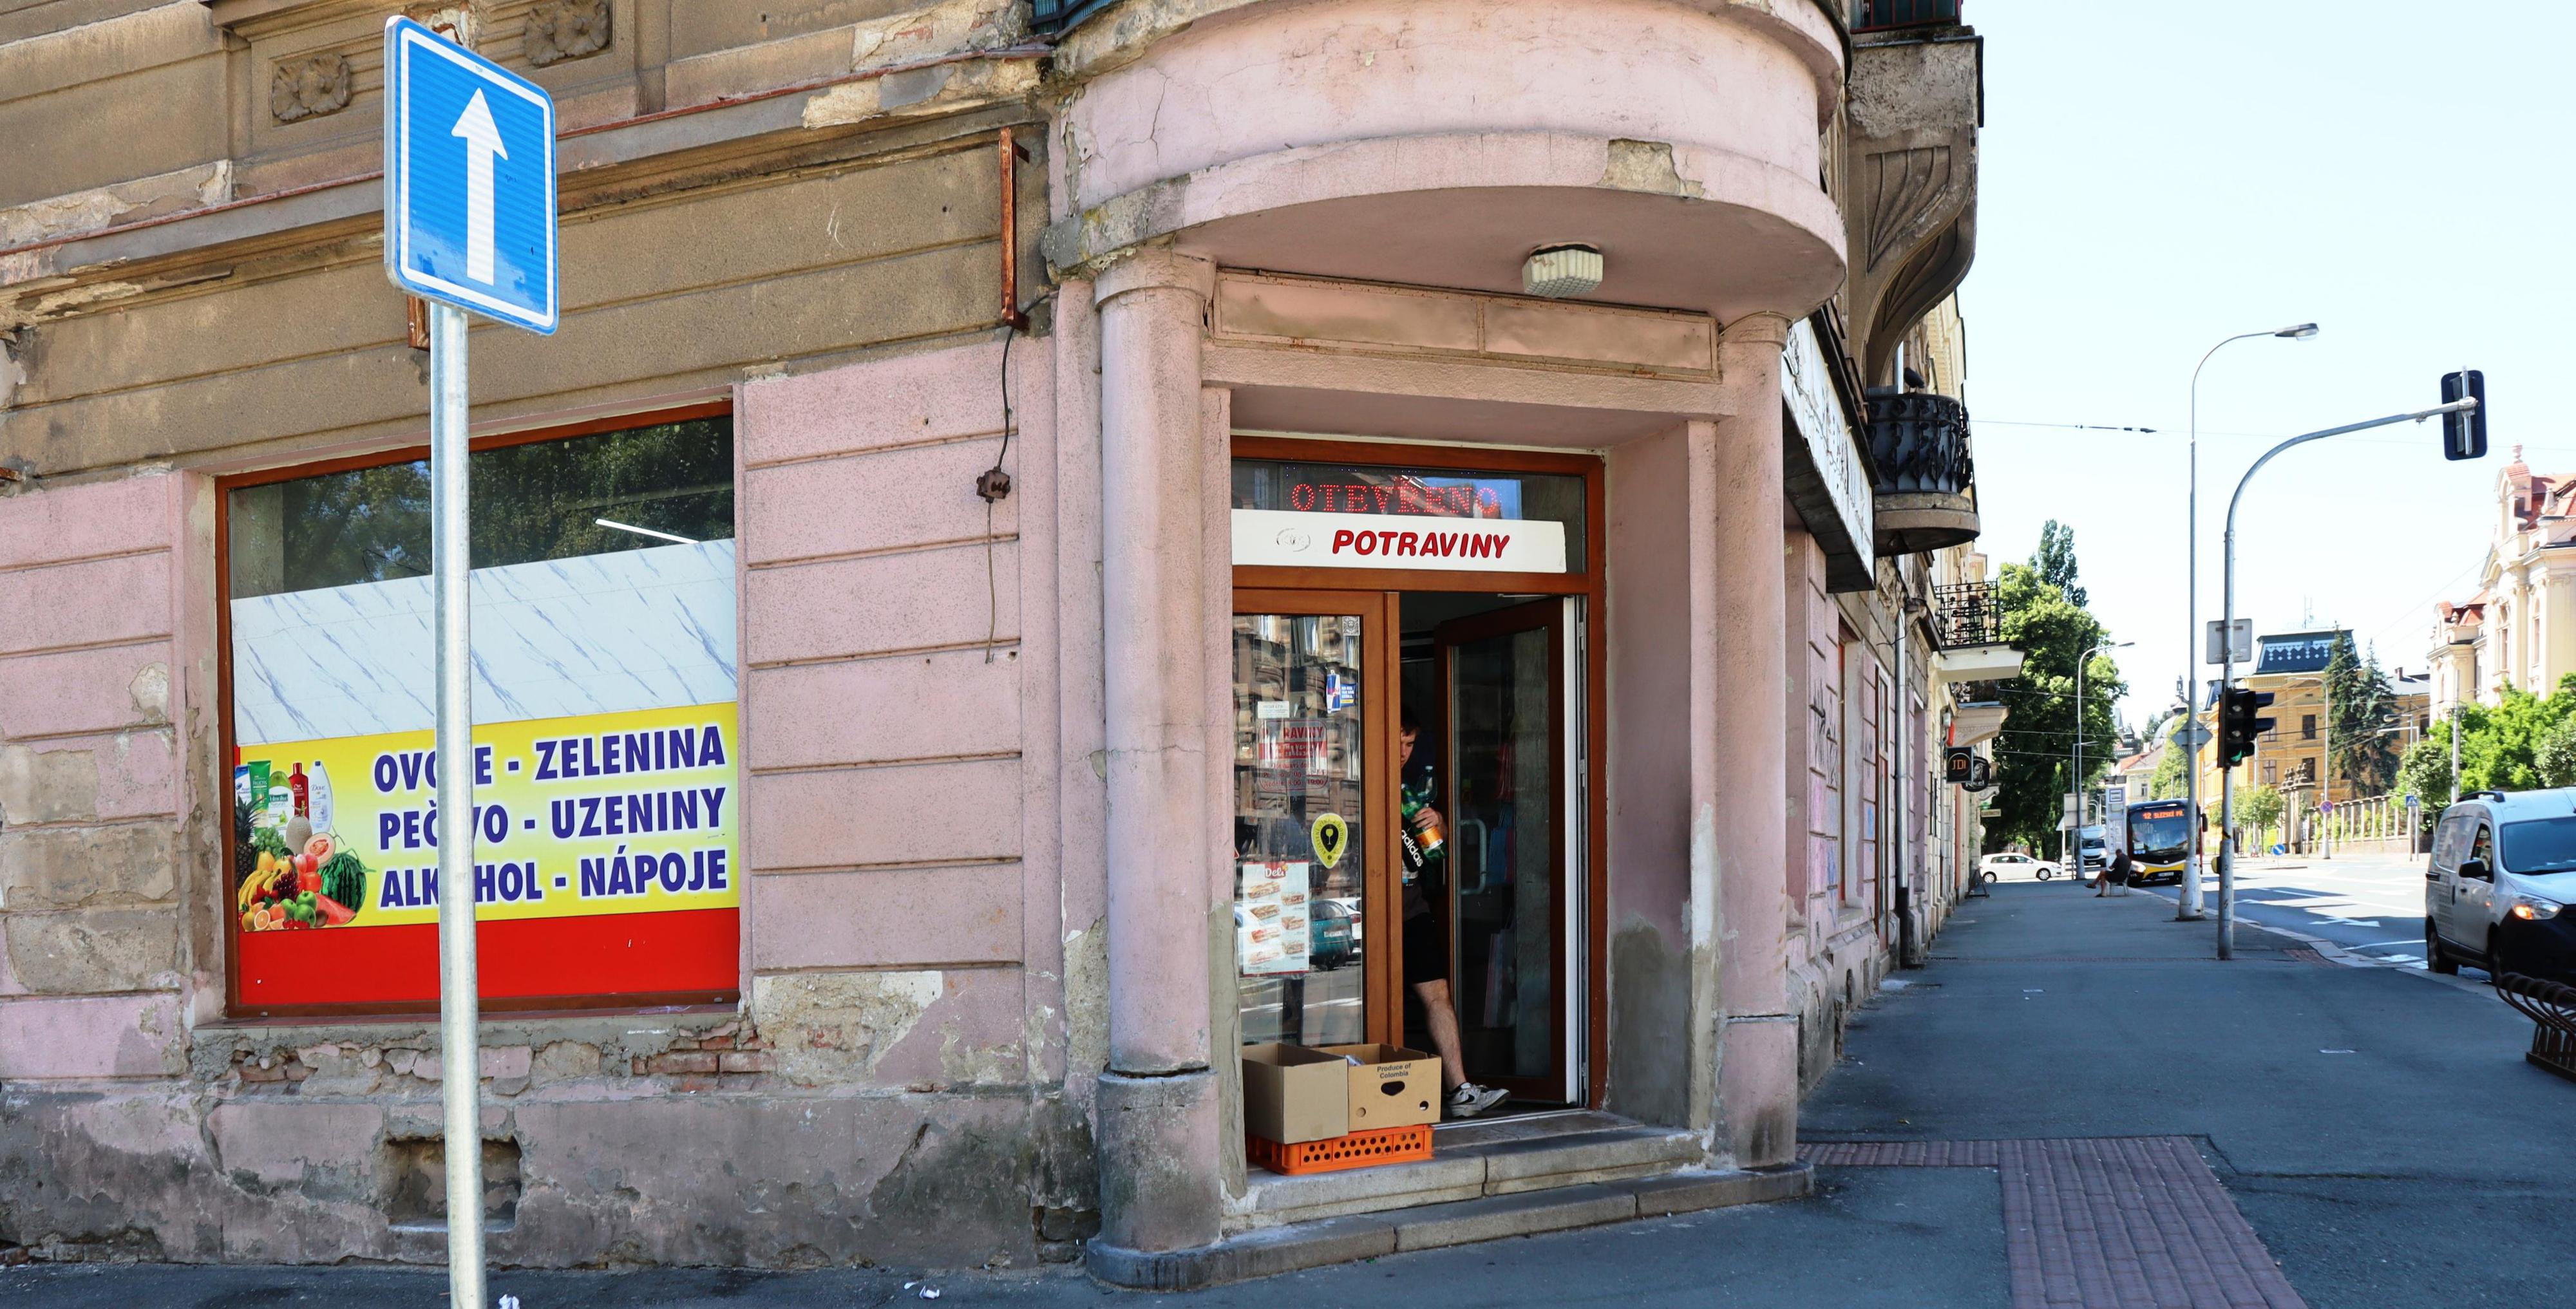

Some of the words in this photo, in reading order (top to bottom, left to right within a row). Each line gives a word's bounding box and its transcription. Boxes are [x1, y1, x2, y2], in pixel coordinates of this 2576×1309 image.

[1291, 475, 1497, 513] OTEVŘENO
[1332, 529, 1510, 559] POTRAVINY
[374, 747, 491, 792] OVE
[536, 726, 725, 780] ZELENINA
[551, 787, 726, 838] UZENINY
[1401, 829, 1423, 867] adidas
[380, 862, 542, 907] ALKHOL
[580, 845, 727, 897] NÁPOJE
[1265, 867, 1285, 878] Deli
[1379, 1069, 1408, 1078] Colombia
